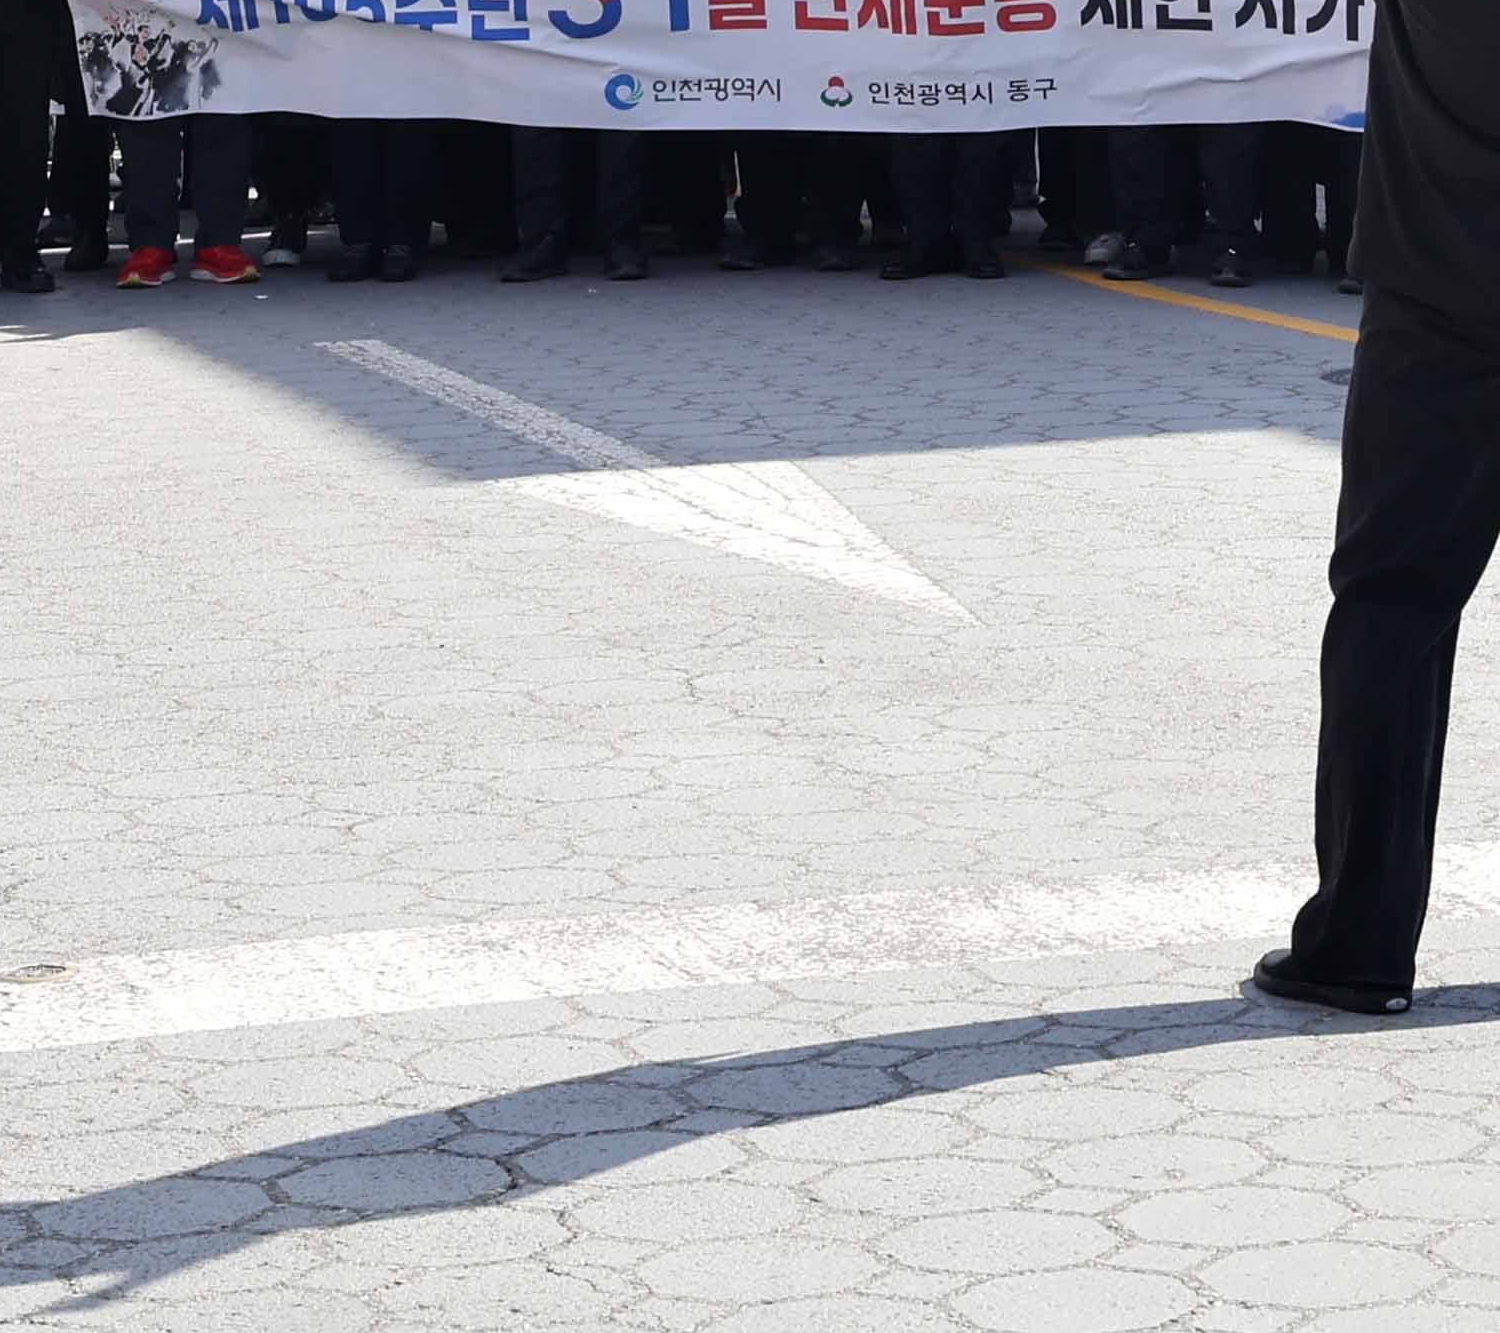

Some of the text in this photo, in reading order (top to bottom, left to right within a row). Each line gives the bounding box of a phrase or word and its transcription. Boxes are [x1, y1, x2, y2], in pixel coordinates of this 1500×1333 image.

[652, 73, 781, 103] 인천광역시
[868, 78, 1058, 106] 인천광역시 동구
